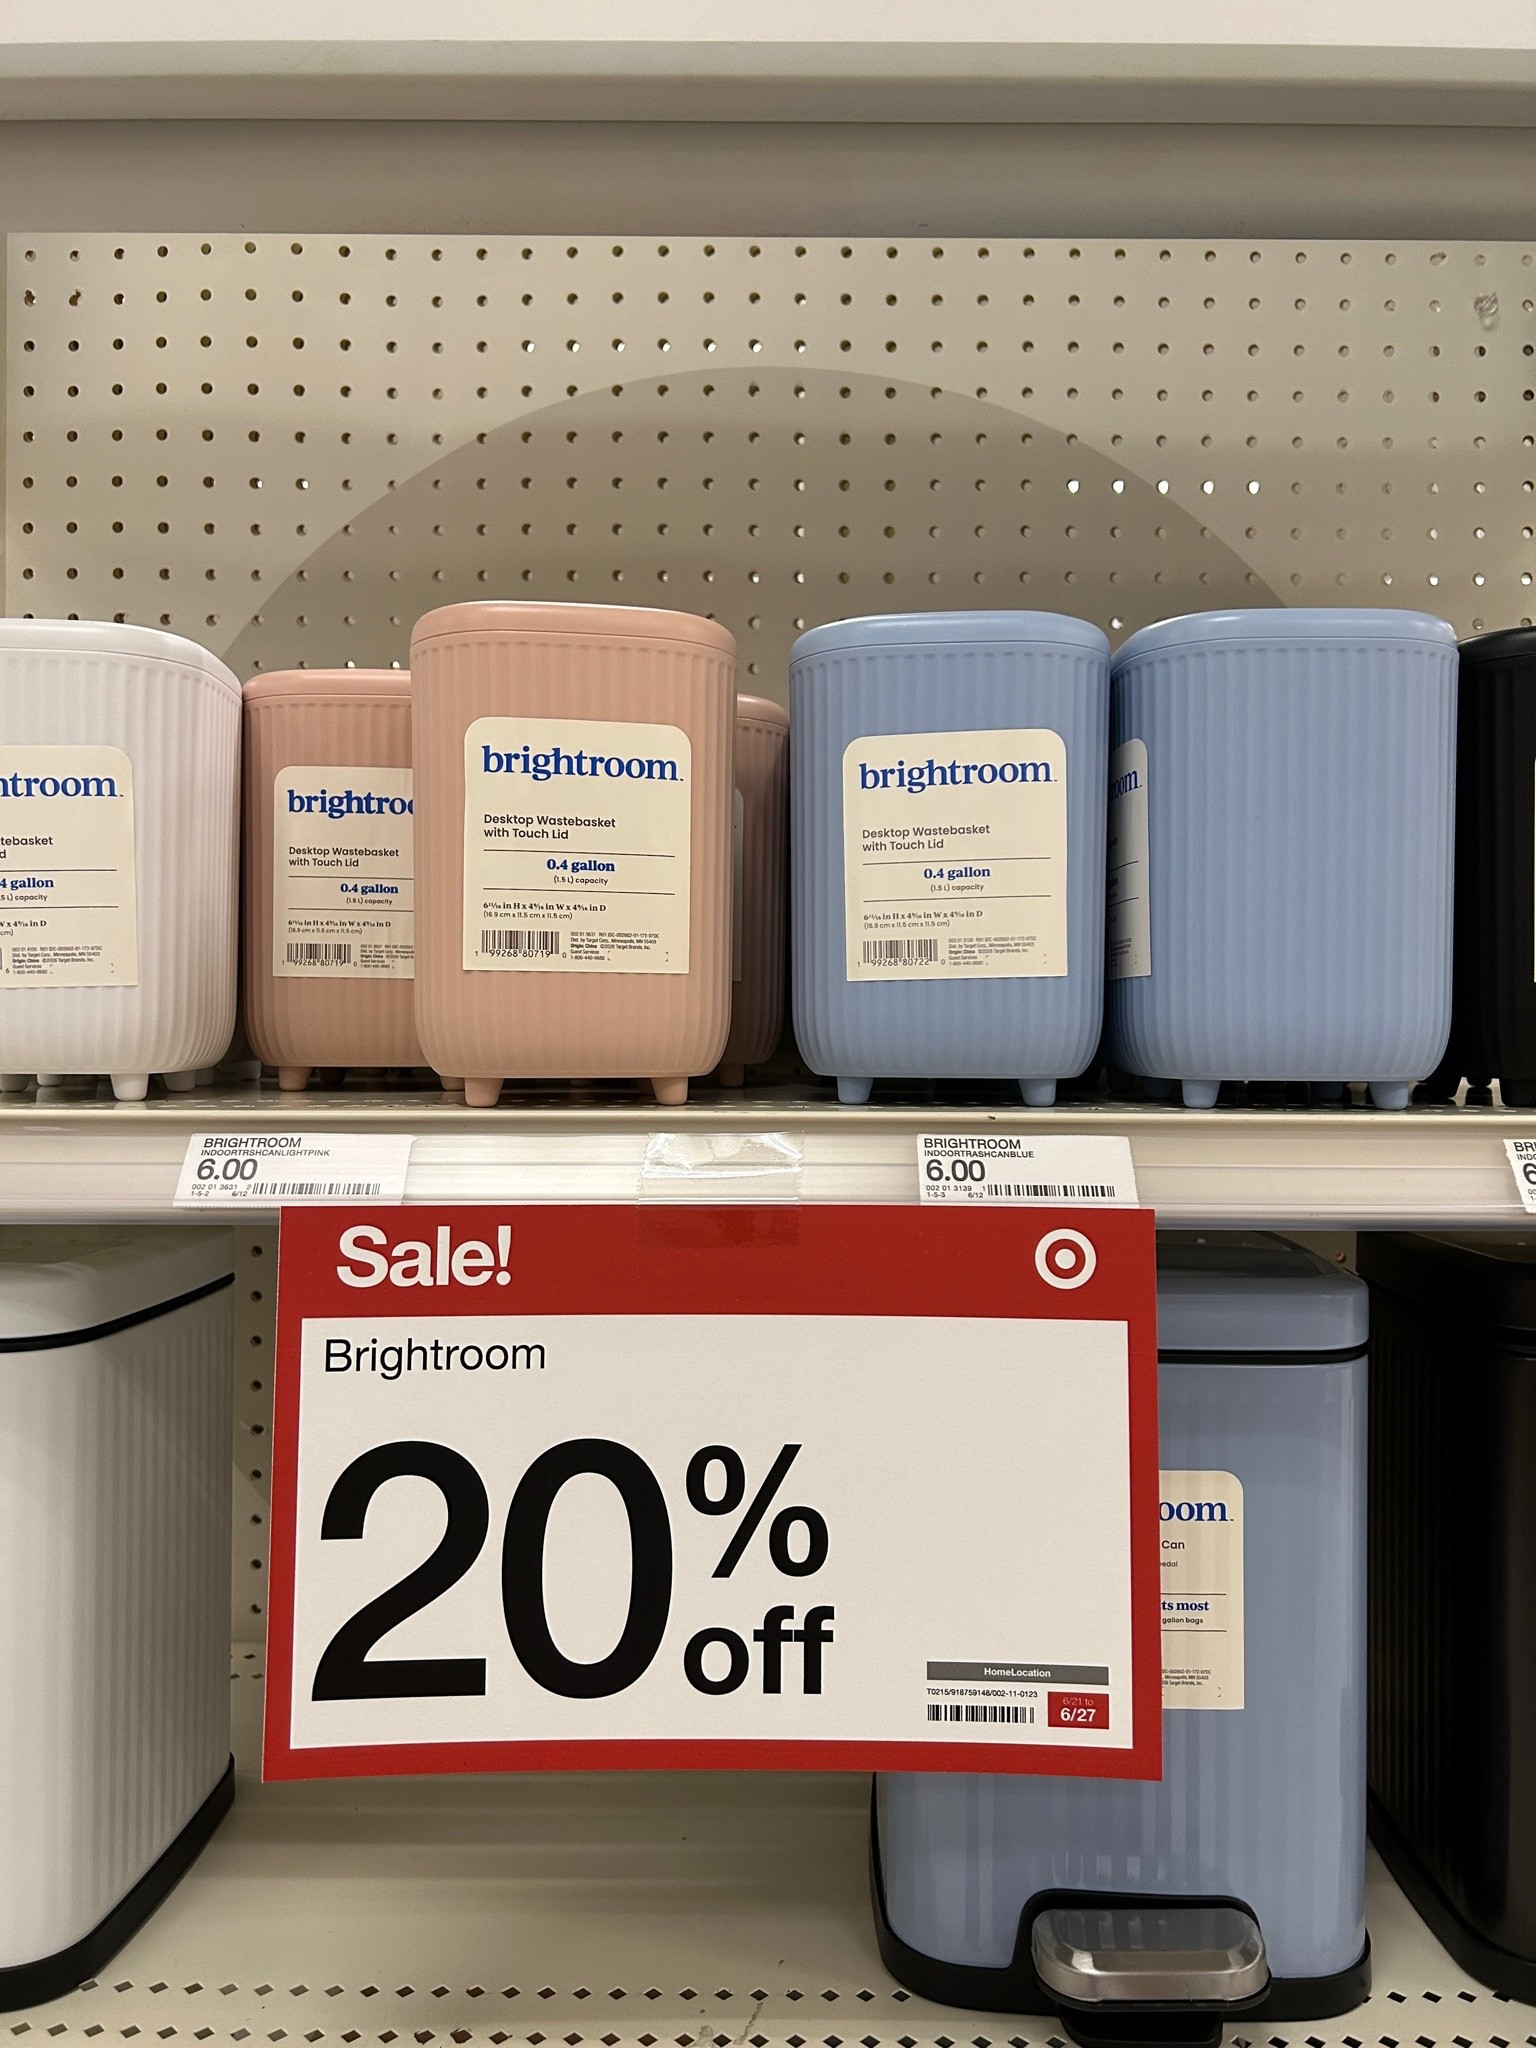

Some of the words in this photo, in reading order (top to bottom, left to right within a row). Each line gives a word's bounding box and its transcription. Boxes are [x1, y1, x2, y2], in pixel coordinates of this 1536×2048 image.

[484, 814, 534, 826] Desktop
[536, 816, 616, 828] Wastebasket
[484, 828, 509, 838] with
[512, 828, 549, 838] Touch
[552, 829, 569, 839] Lid
[862, 828, 910, 839] Desktop
[913, 825, 990, 836] Wastebasket
[862, 841, 887, 851] with
[890, 840, 925, 850] Touch
[928, 839, 944, 849] Lid
[289, 846, 330, 856] Desktop
[332, 848, 400, 858] Wastebasket
[289, 858, 310, 867] with
[312, 858, 342, 867] Touch
[345, 859, 359, 868] Lid
[546, 859, 568, 870] 0.4
[572, 860, 615, 873] gallon
[924, 868, 944, 879] 0.4
[948, 867, 991, 880] gallon
[10, 878, 54, 890] gallon
[554, 876, 567, 884] (1.5
[576, 876, 608, 885] capacity
[340, 884, 358, 893] 0.4
[361, 884, 399, 895] gallon
[952, 884, 984, 892] capacity
[204, 1137, 301, 1148] BRIGHTROOM
[924, 1138, 1021, 1149] BRIGHTROOM
[197, 1158, 258, 1180] 6.00
[926, 1159, 986, 1181] 6.00
[336, 1225, 512, 1288] Sale!
[325, 1340, 546, 1380] Brightroom
[1162, 1540, 1185, 1549] Can
[1176, 1601, 1209, 1611] most
[684, 1606, 834, 1696] off
[984, 1667, 1051, 1677] HomeLocation
[1063, 1697, 1083, 1706] 6/21
[1060, 1708, 1096, 1722] 6/27
